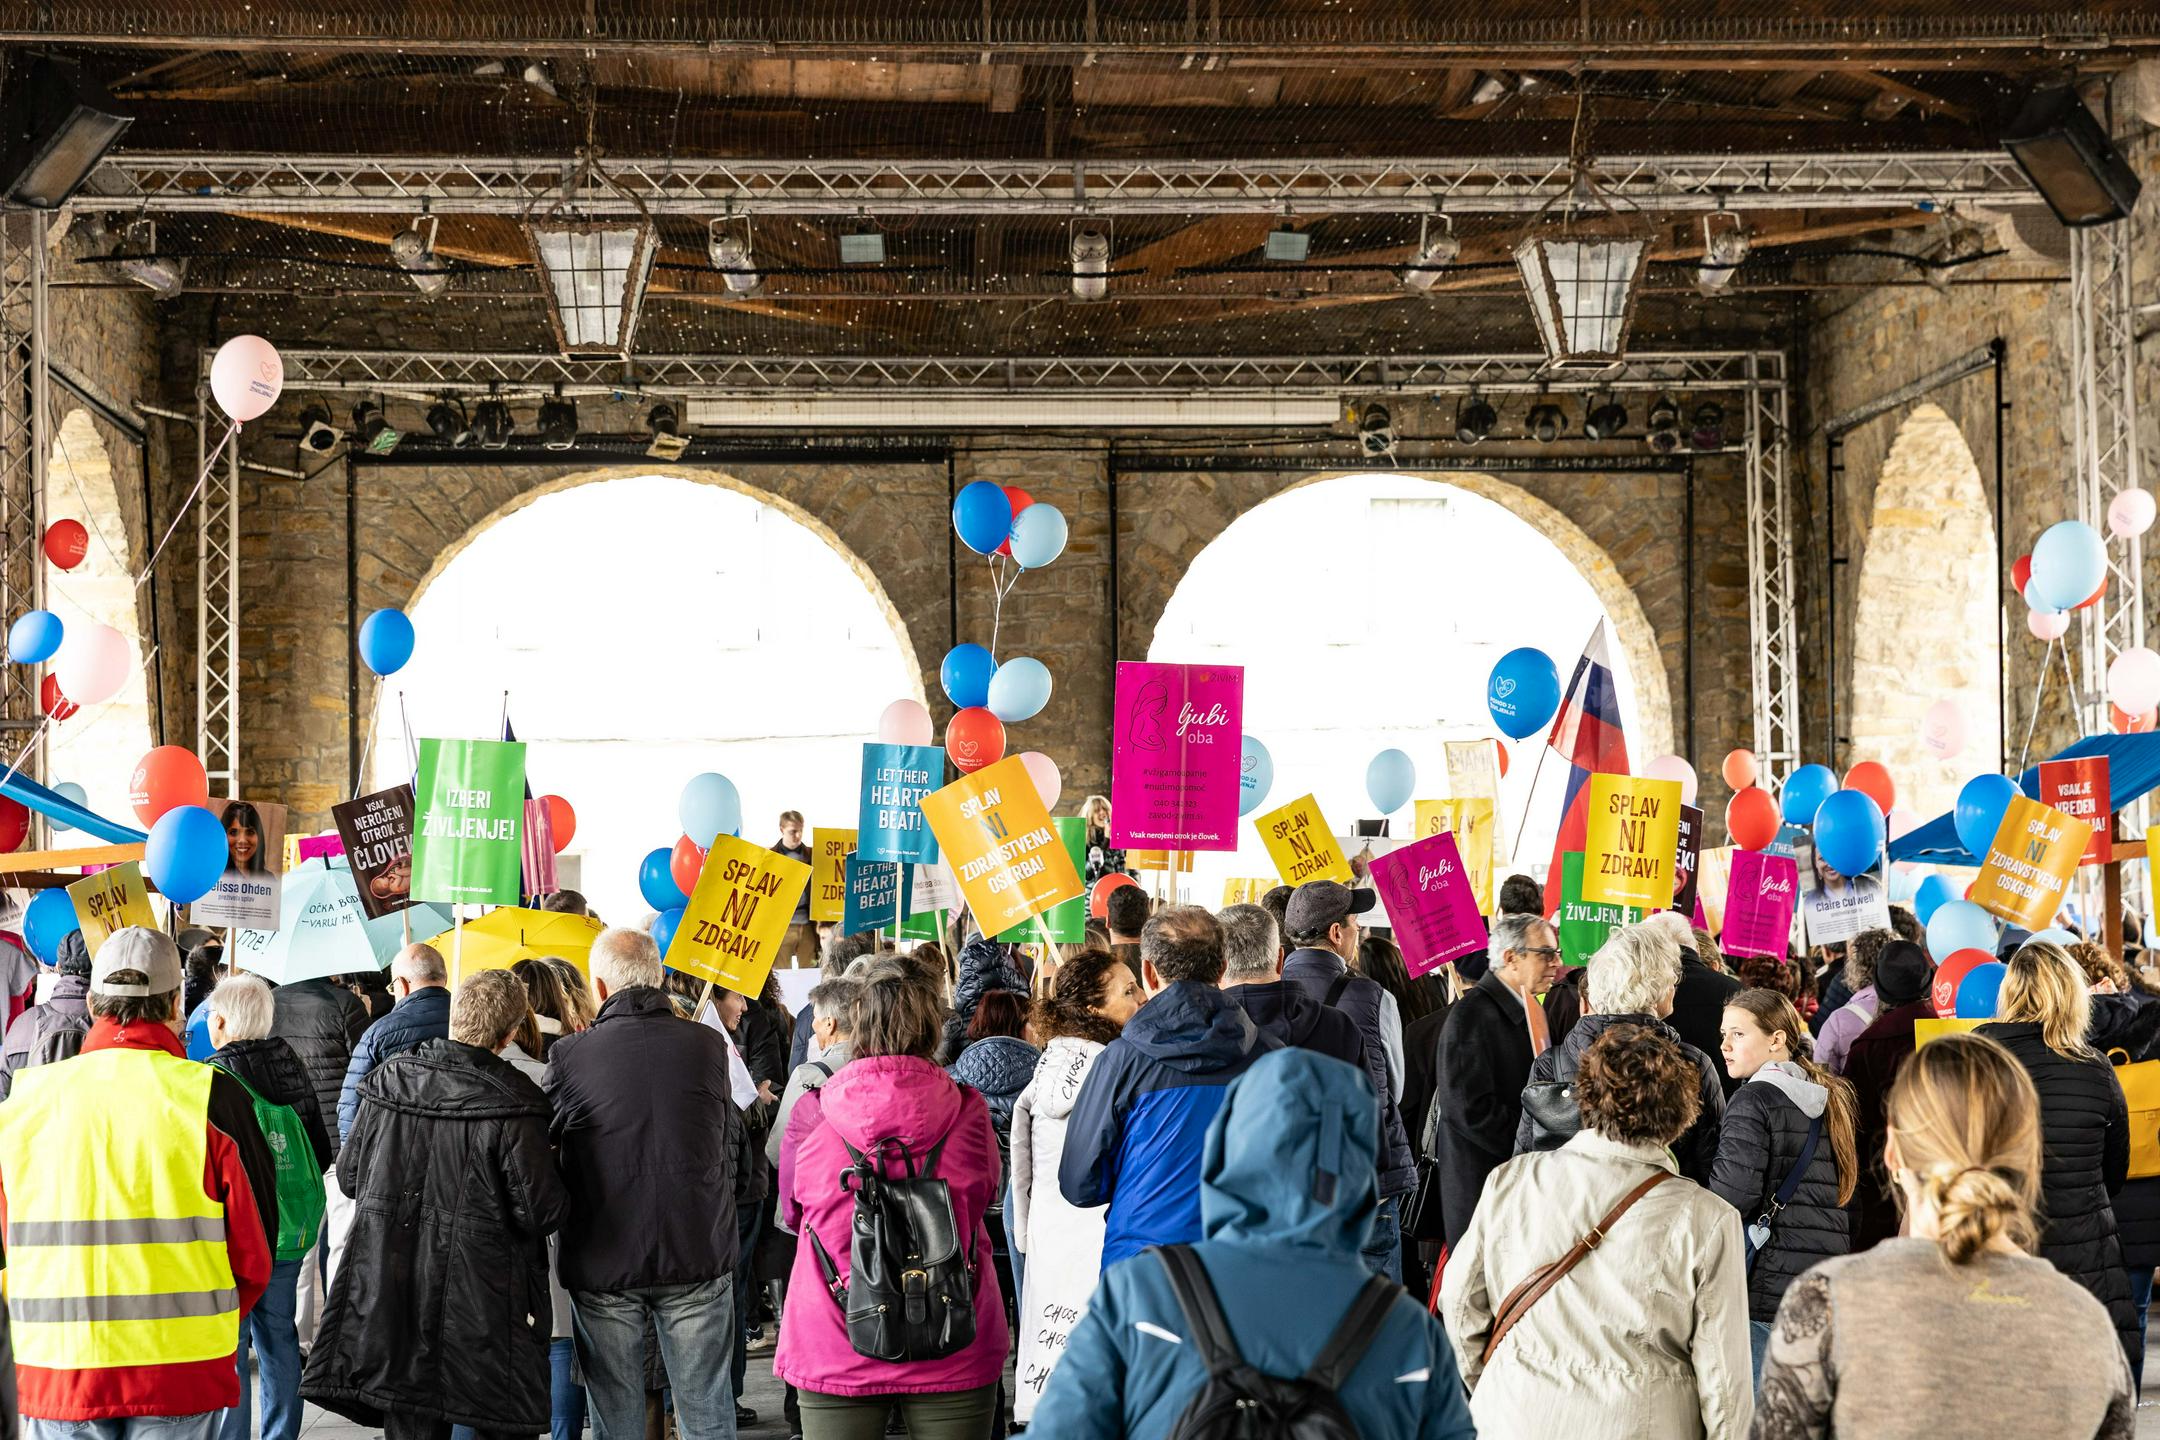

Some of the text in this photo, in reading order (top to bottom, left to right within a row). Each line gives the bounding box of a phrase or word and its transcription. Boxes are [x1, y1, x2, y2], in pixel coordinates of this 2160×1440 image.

[1176, 702, 1230, 737] ljubi
[1188, 730, 1213, 744] oba
[877, 768, 928, 784] LET THEIR
[446, 788, 491, 809] IZBERI
[2058, 781, 2093, 797] VSAK JE
[959, 787, 1002, 820] SPLAV
[1609, 793, 1660, 818] SPLAV
[2055, 798, 2096, 815] VREDEN
[354, 805, 404, 831] NEROJENI
[422, 811, 515, 841] ŽIVLJENJE!
[879, 809, 922, 832] BEAT!
[980, 812, 1009, 844] NI
[1272, 811, 1310, 840] SPLAV
[361, 823, 406, 844] OTROK JE
[1129, 831, 1146, 839] Vsak
[1147, 832, 1173, 841] nerojeni
[1174, 832, 1191, 840] otrok
[1619, 818, 1646, 854] NI
[1679, 837, 1688, 848] JE
[2027, 819, 2063, 844] SPLAV
[959, 826, 1053, 883] ZDRAVSTVENA
[1288, 830, 1315, 860] NI
[2024, 840, 2047, 864] NI
[834, 859, 846, 882] N
[857, 862, 897, 876] LET THEI
[987, 854, 1046, 895] OSKRBA!
[1289, 850, 1334, 881] ZDRAV!
[1419, 858, 1454, 892] ljubi
[1600, 854, 1660, 879] ZDRAV!
[211, 880, 272, 896] elissa Ohden
[723, 859, 783, 897] SPLAV
[1430, 880, 1449, 892] oba
[88, 884, 128, 918] SPLAV
[822, 885, 845, 901] ZDR
[859, 888, 897, 910] BEAT!
[1816, 893, 1875, 912] Claire Culwell
[309, 903, 334, 914] OČKA
[720, 888, 760, 931] NI
[692, 919, 761, 963] ZDRAV!
[1062, 1046, 1088, 1100] CHOOSE
[1043, 1303, 1078, 1324] CHOOS
[1037, 1329, 1067, 1349] CHOO
